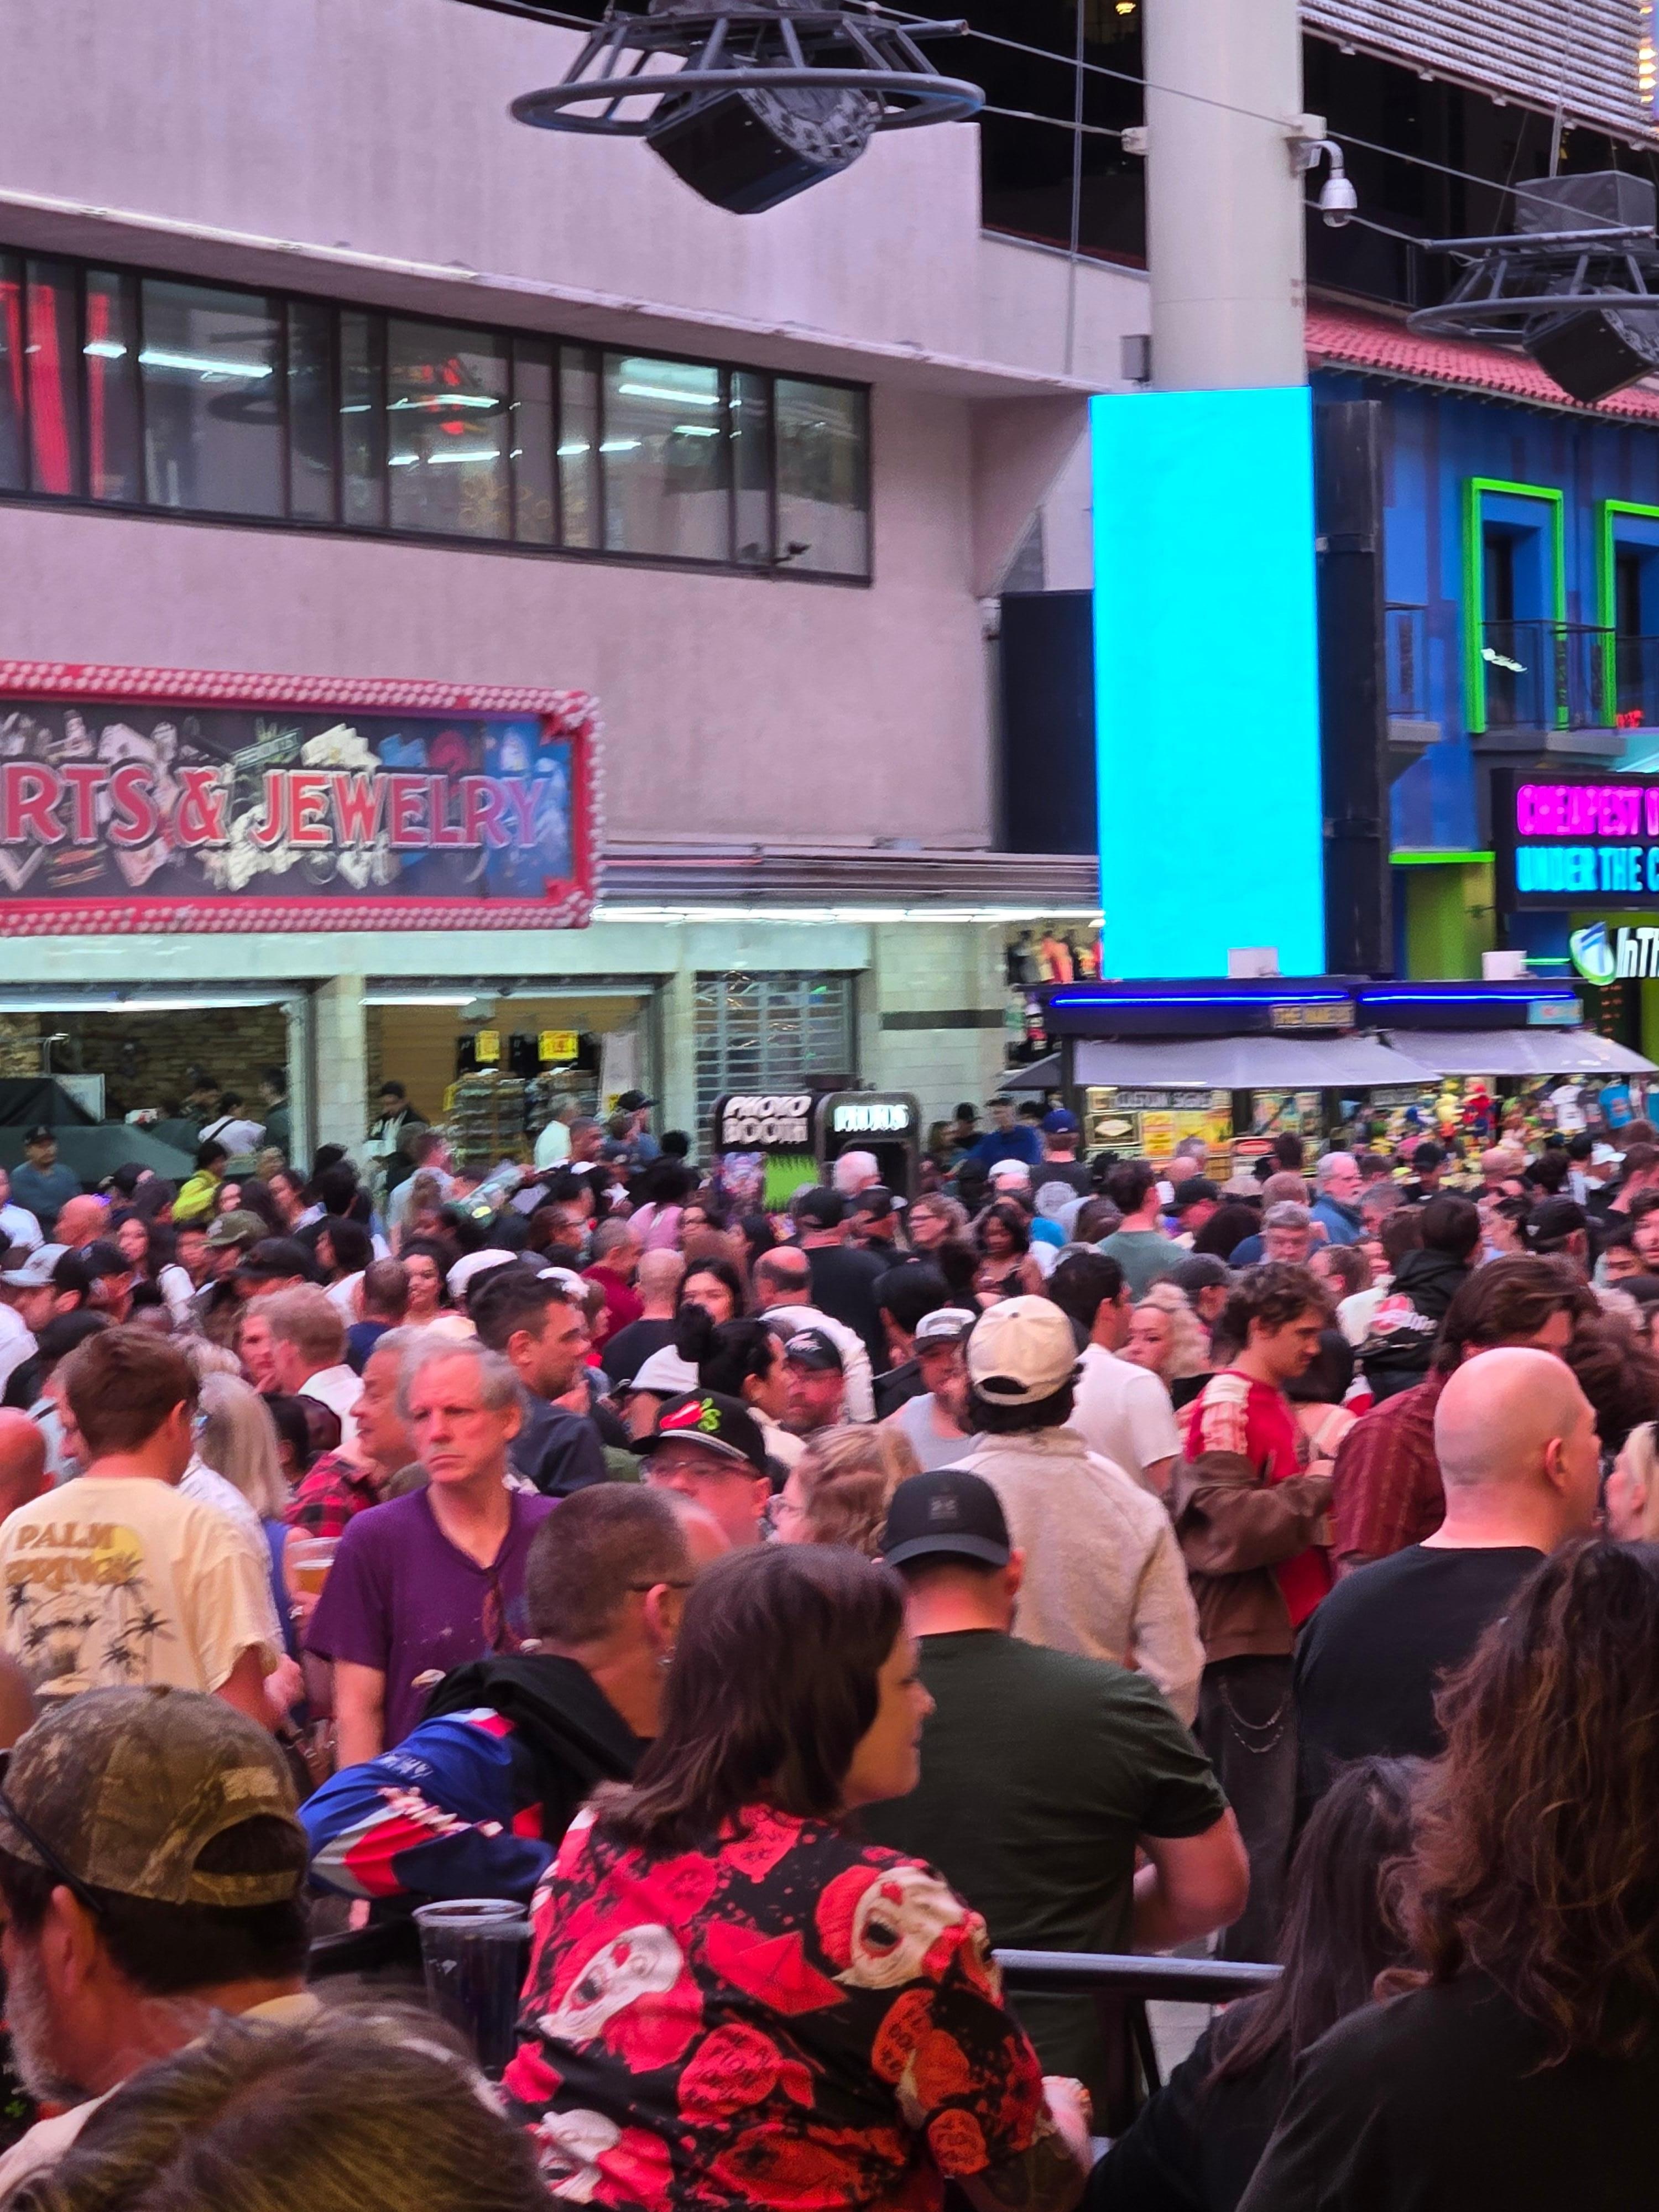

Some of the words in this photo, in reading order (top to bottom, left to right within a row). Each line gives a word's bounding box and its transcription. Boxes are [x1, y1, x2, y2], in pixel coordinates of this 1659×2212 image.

[1, 762, 159, 847] RTS
[174, 765, 232, 847] &
[251, 769, 547, 849] JEWELRY
[1516, 847, 1597, 891] UNDER
[1598, 847, 1644, 891] THE
[15, 1521, 115, 1551] PALM
